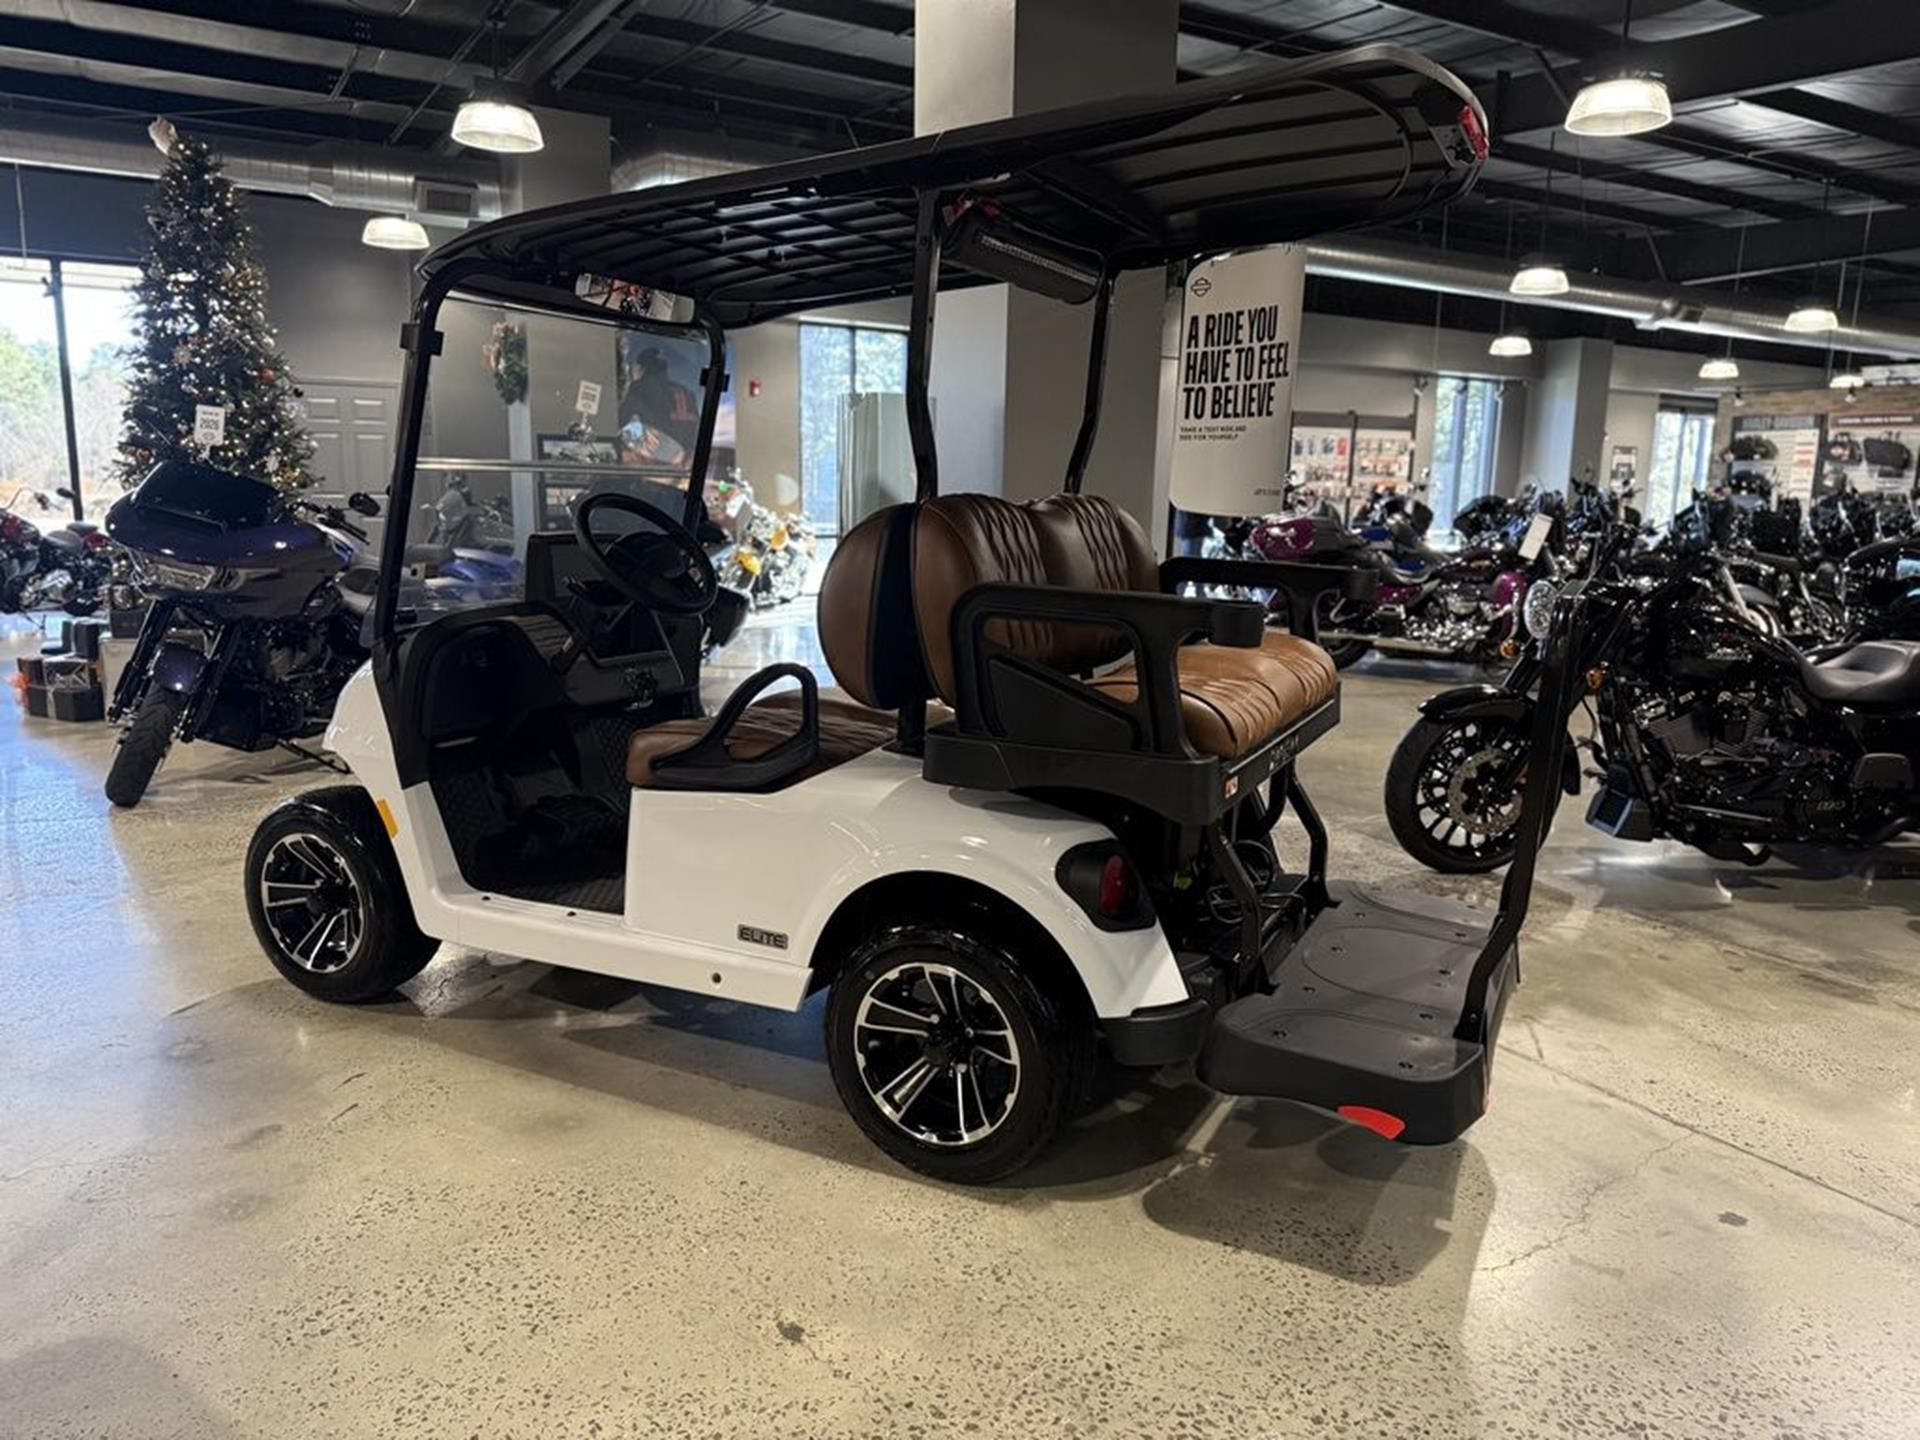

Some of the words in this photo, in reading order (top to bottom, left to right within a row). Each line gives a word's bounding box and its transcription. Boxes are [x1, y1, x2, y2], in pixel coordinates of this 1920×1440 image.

[1187, 315, 1198, 348] A
[1204, 310, 1244, 347] RIDE
[1248, 305, 1278, 343] YOU
[1185, 350, 1231, 384] HAVE
[1235, 347, 1254, 381] TO
[1258, 342, 1289, 379] FEEL
[1183, 387, 1206, 419] TO
[1211, 382, 1275, 418] BELIEVE
[740, 926, 785, 949] ELITE
